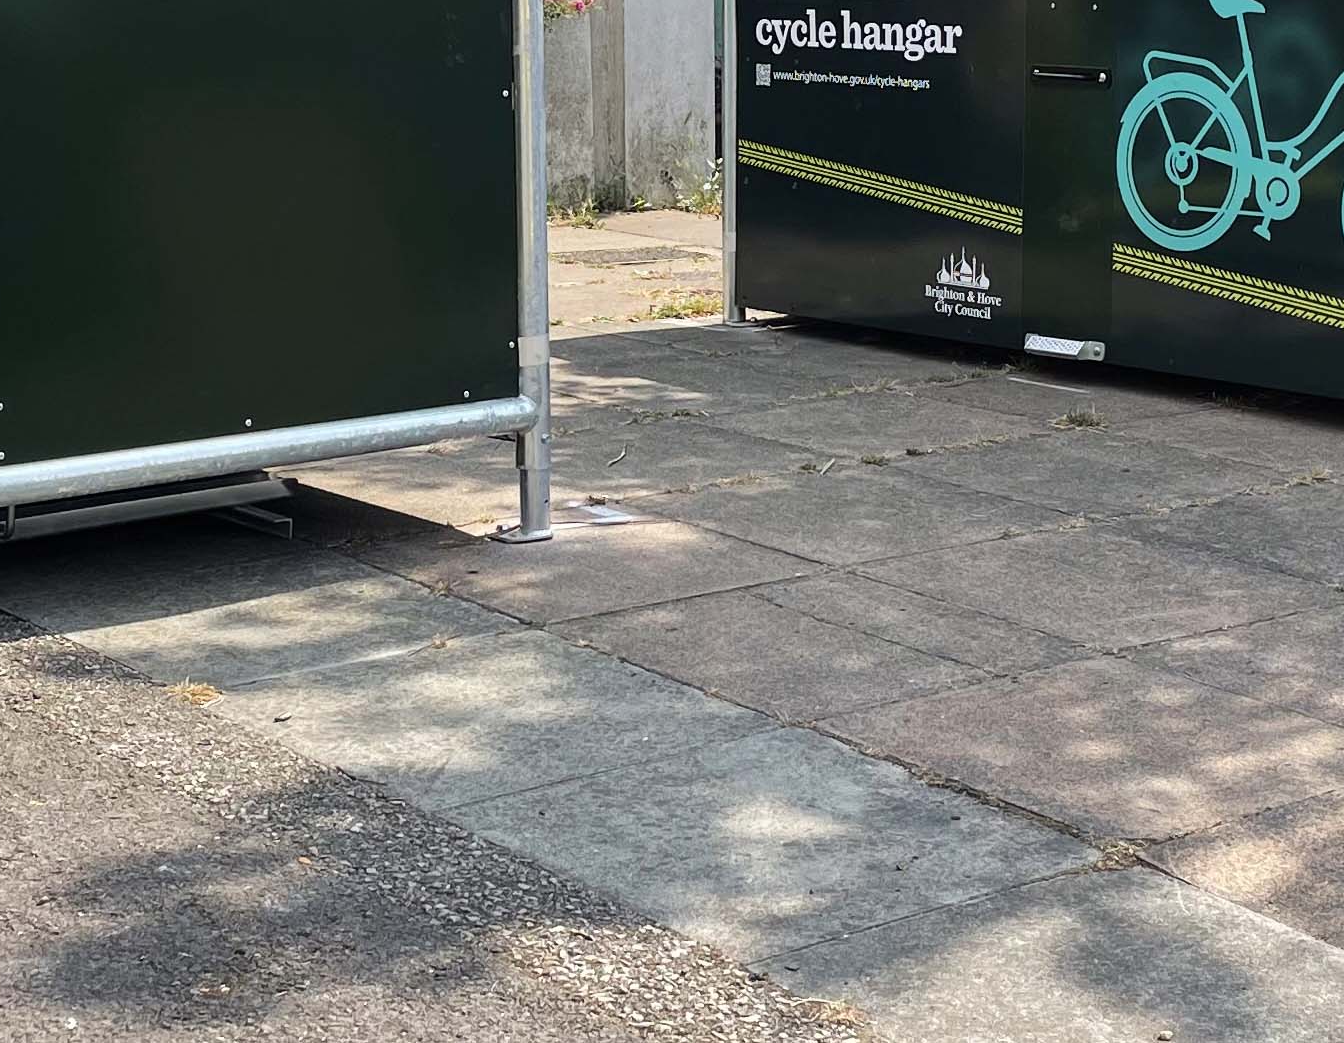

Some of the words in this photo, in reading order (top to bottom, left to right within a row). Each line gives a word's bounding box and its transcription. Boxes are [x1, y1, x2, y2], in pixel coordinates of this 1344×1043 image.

[755, 9, 837, 55] cycle
[840, 9, 963, 62] hangar
[772, 69, 931, 91] www.brighton-hove.gov.uk/cycle-hangars
[924, 284, 965, 302] Brighton
[966, 291, 976, 303] &
[976, 292, 1002, 306] Hove
[934, 300, 954, 317] City
[955, 303, 992, 320] Council
